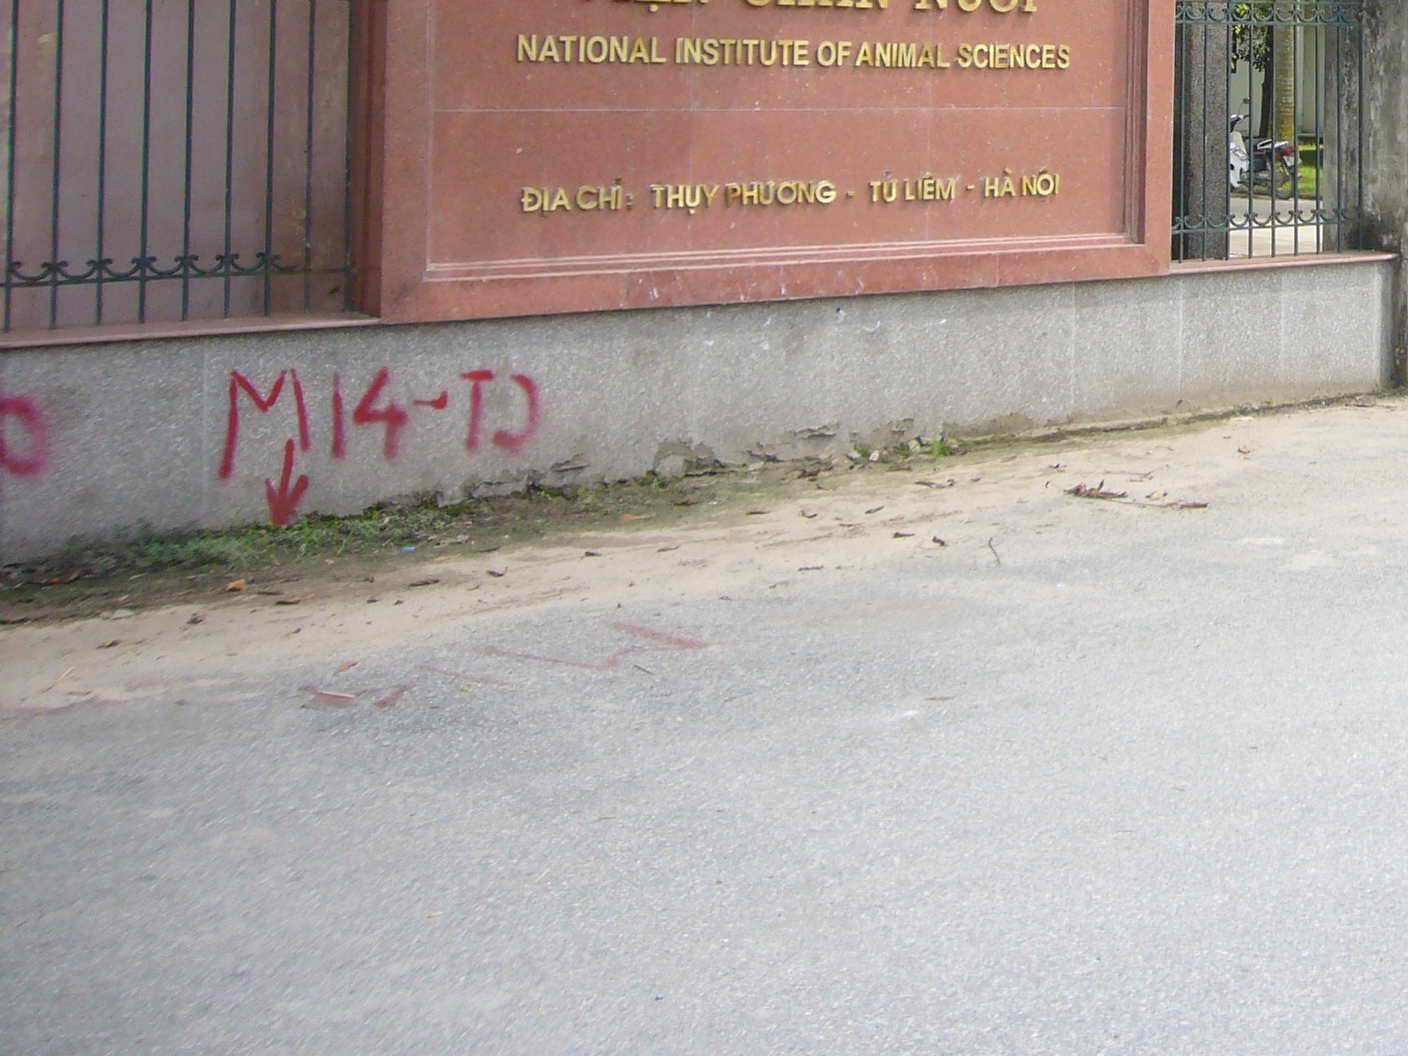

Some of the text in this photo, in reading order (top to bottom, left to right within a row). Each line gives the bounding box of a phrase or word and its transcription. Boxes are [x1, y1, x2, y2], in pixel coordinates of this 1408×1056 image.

[517, 35, 1071, 70] NATIONAL INSTITUTE OF ANIMAL SCIENCES
[650, 183, 719, 214] THỤY
[724, 180, 837, 208] PHƯƠNG
[904, 172, 956, 201] LIÊM
[984, 167, 1016, 197] HÀ
